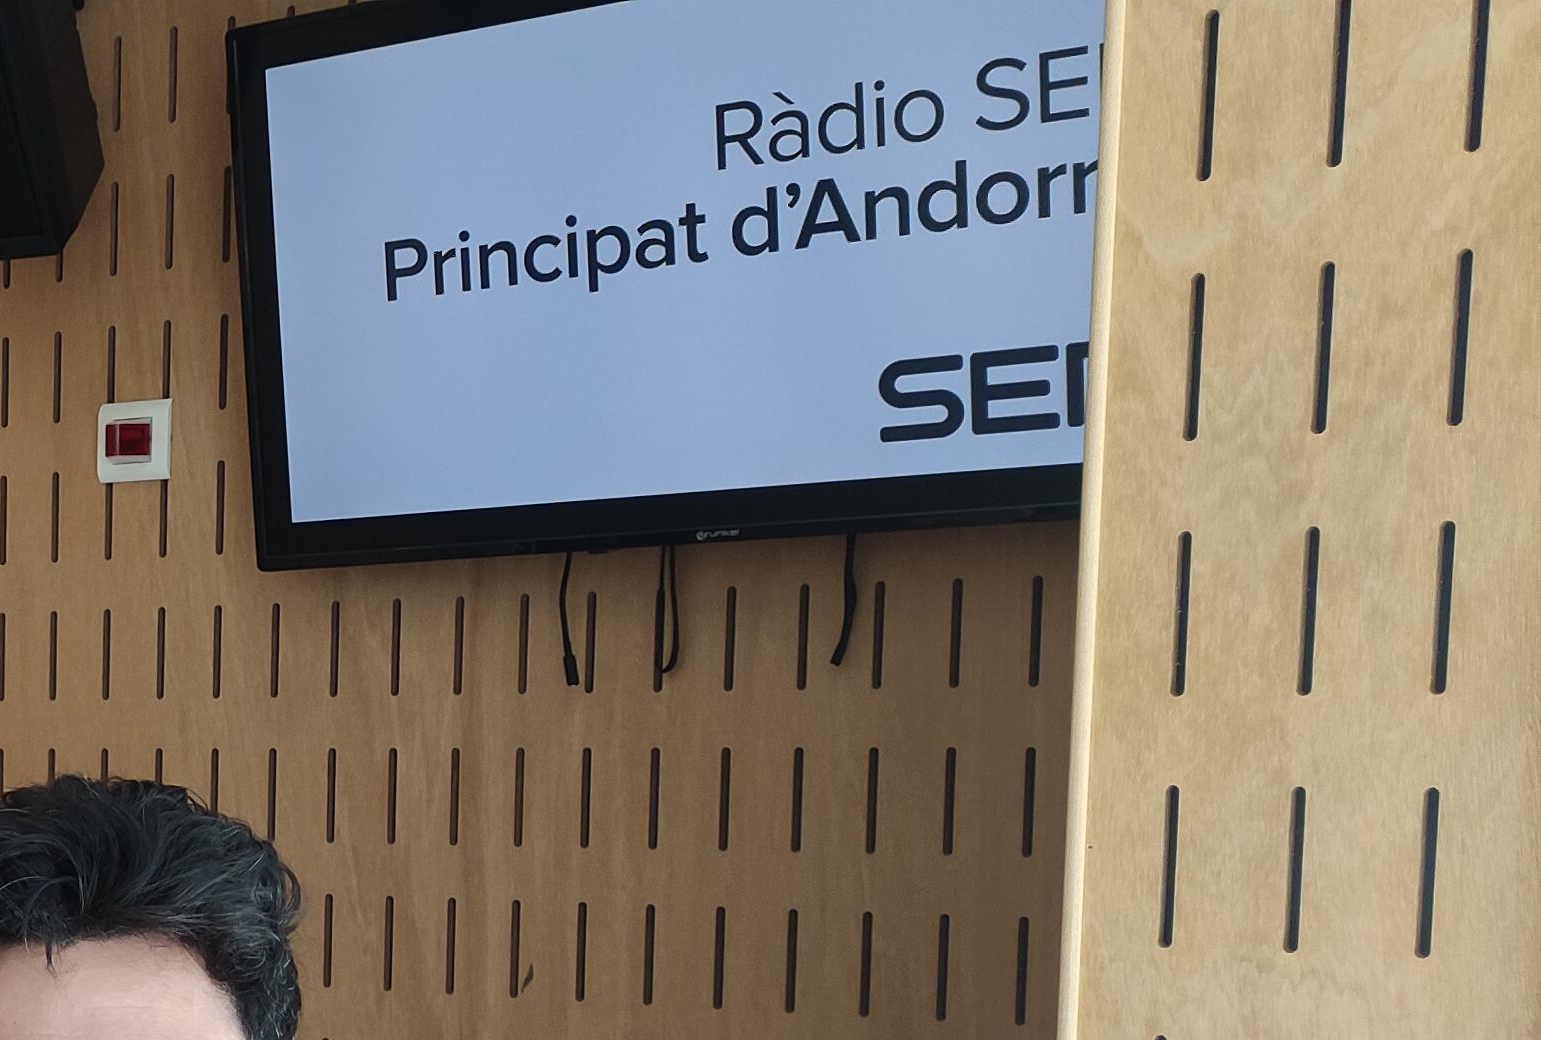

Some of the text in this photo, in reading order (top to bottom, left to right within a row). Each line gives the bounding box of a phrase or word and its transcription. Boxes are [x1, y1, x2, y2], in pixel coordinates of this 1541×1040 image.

[715, 42, 1104, 170] Ràdio SE
[384, 202, 710, 302] Principat
[878, 341, 1090, 443] SE
